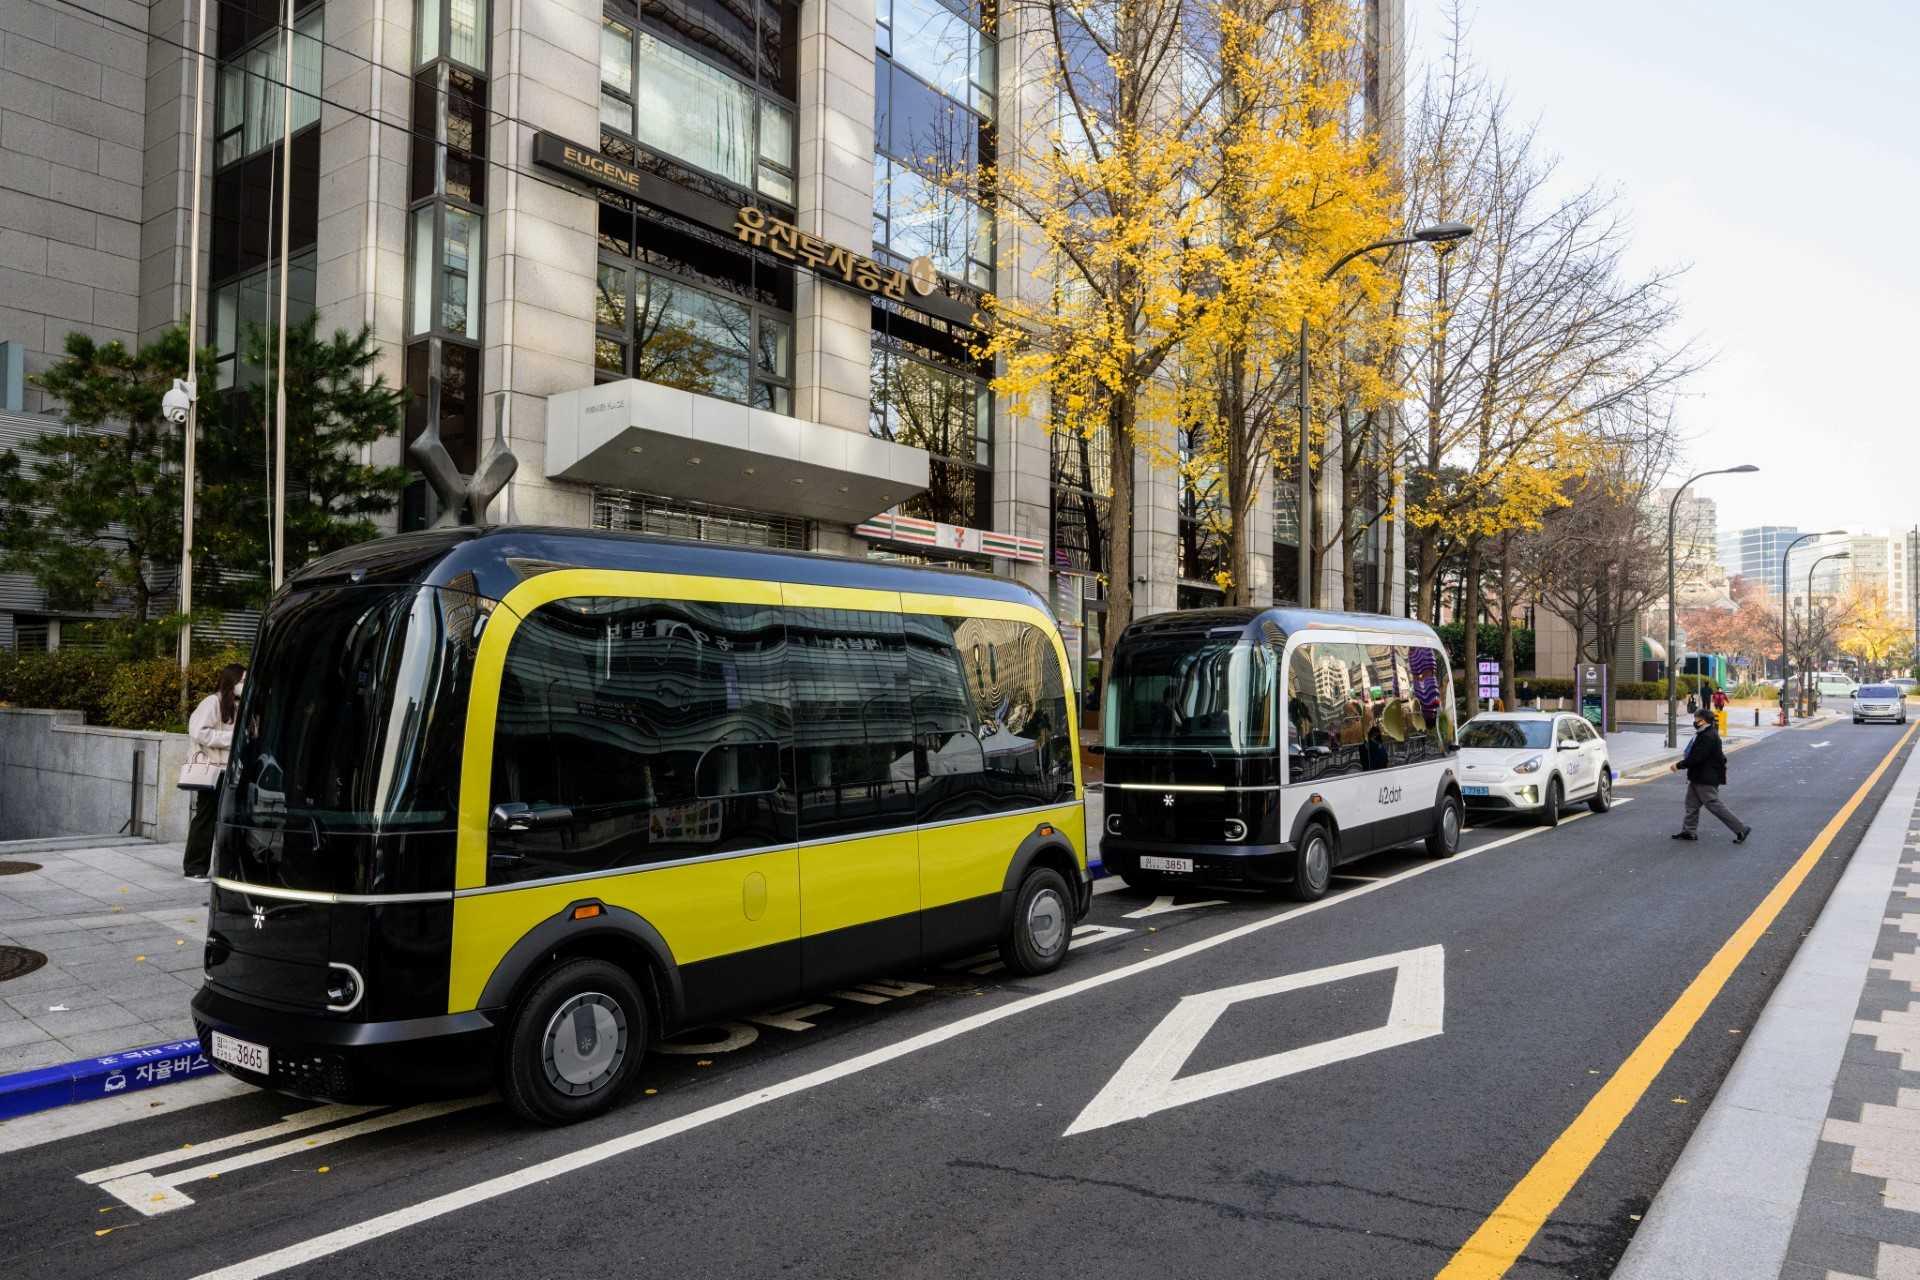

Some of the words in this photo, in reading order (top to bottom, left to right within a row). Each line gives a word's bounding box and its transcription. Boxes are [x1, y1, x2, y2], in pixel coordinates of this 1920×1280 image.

[563, 146, 641, 187] EUGENE
[734, 206, 909, 301] 유진투자증권
[1379, 785, 1402, 804] 42dot
[1165, 860, 1186, 870] 3851
[136, 1054, 209, 1081] 자율버스
[237, 1044, 263, 1069] 3865
